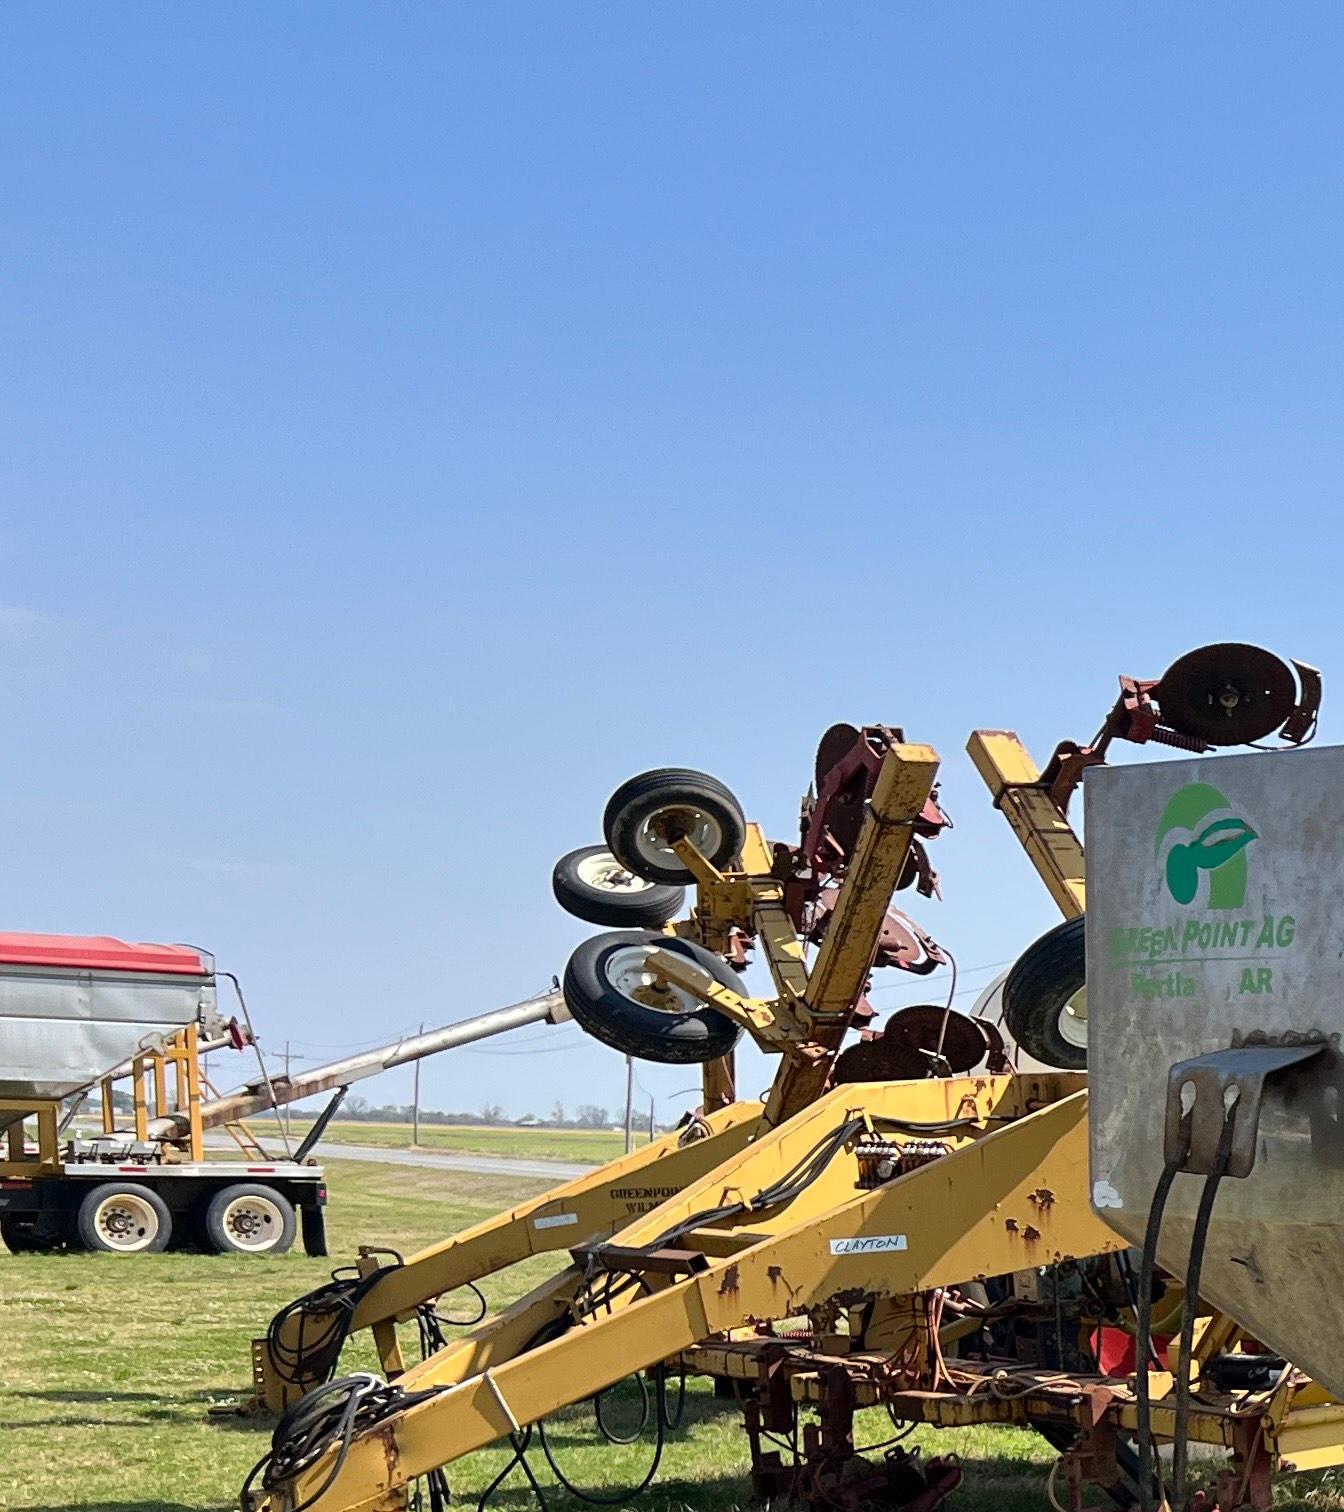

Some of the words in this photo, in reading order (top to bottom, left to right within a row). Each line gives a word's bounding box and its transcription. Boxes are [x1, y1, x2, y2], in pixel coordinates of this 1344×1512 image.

[1181, 919, 1256, 952] POINT
[1255, 914, 1296, 949] AG
[1239, 967, 1273, 995] AR
[834, 1236, 899, 1253] CLAYTON
